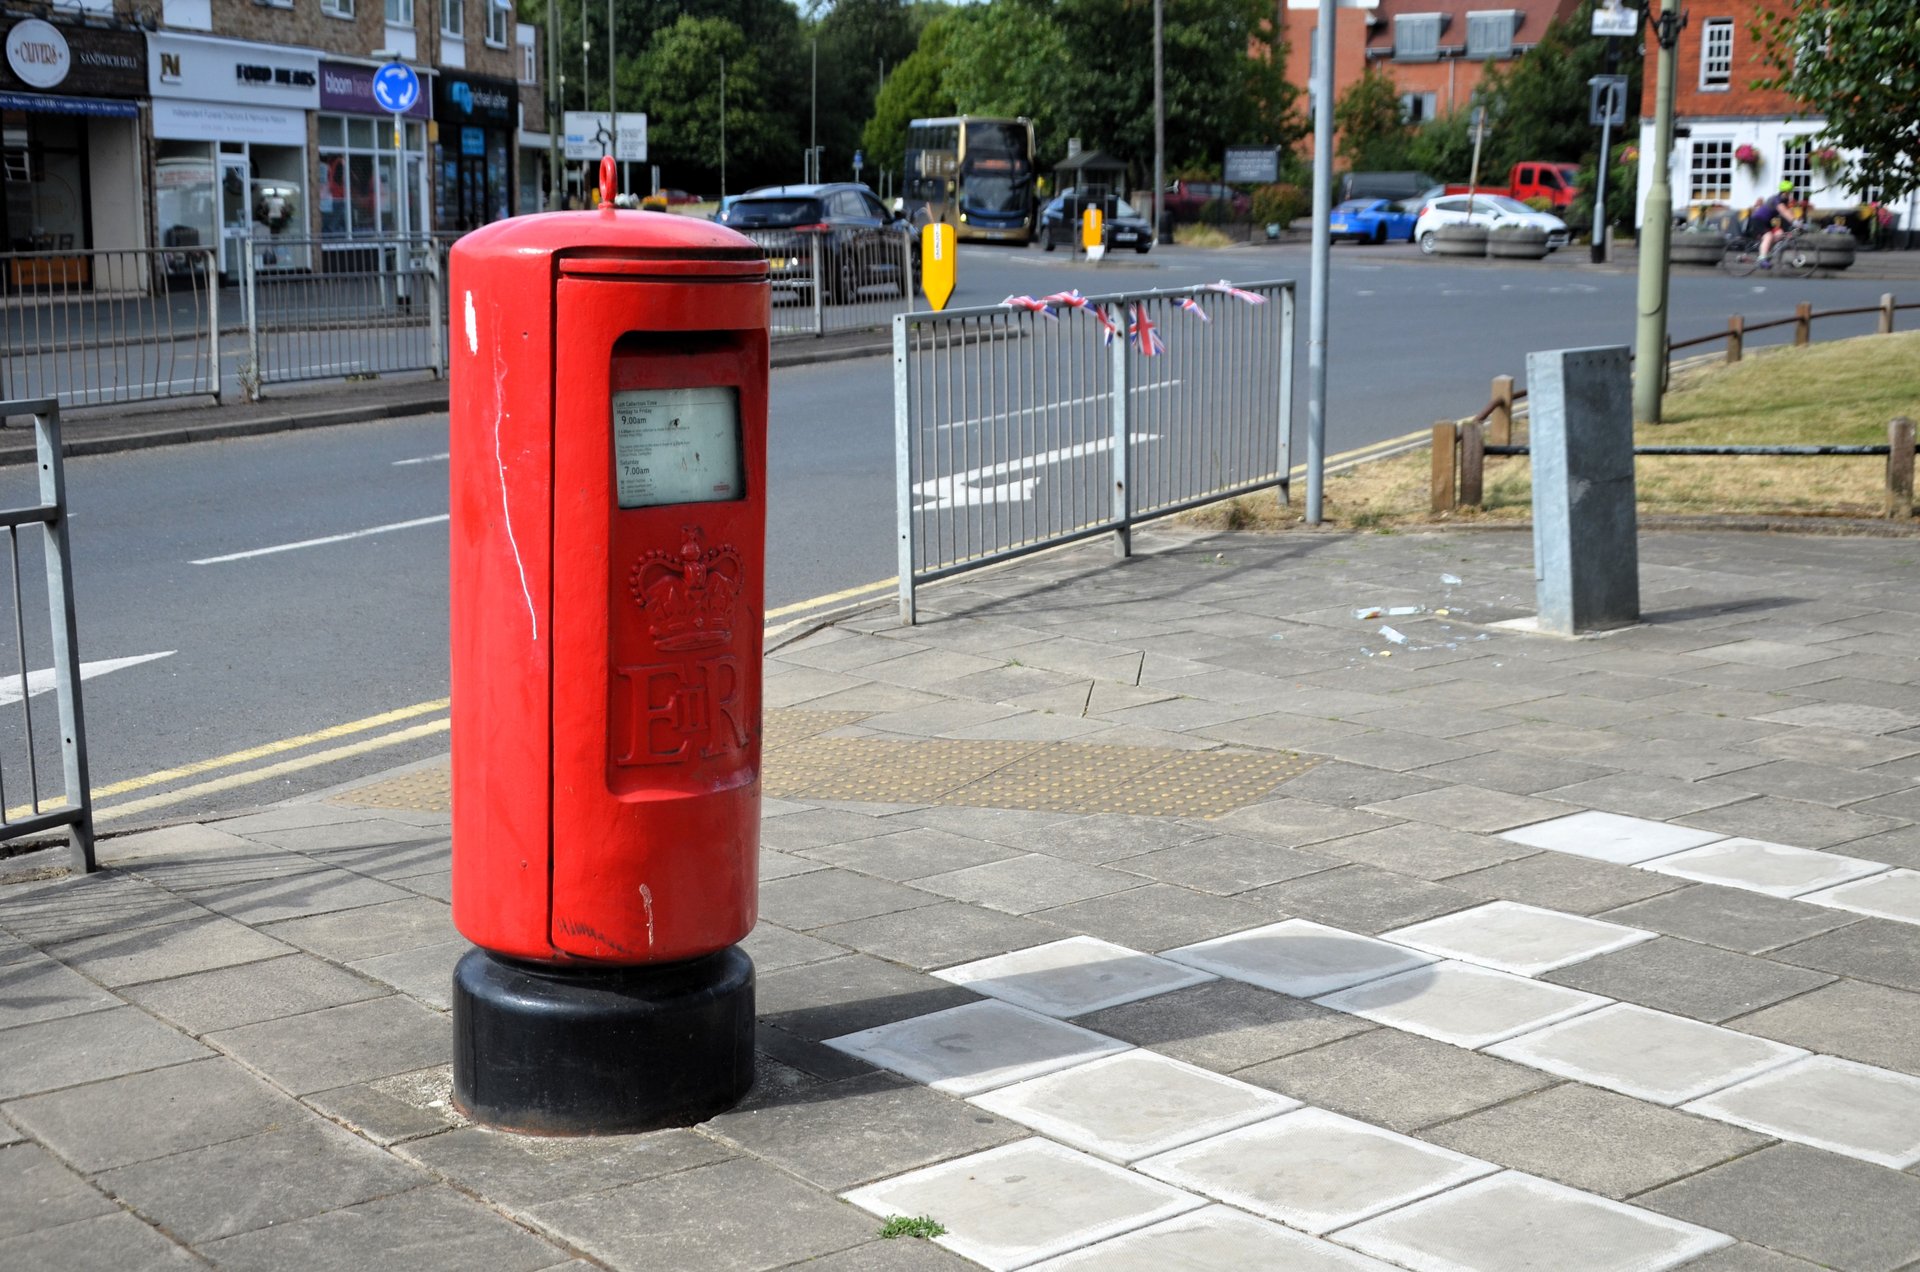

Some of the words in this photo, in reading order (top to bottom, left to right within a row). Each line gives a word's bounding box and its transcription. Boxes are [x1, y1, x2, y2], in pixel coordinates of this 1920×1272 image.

[20, 41, 57, 65] OLIVERS
[80, 51, 119, 68] SANDWICH
[120, 56, 137, 69] DELI
[236, 63, 272, 83] FORD
[324, 70, 353, 95] bloom
[621, 416, 647, 425] 9.00am
[624, 466, 650, 476] 7.00am
